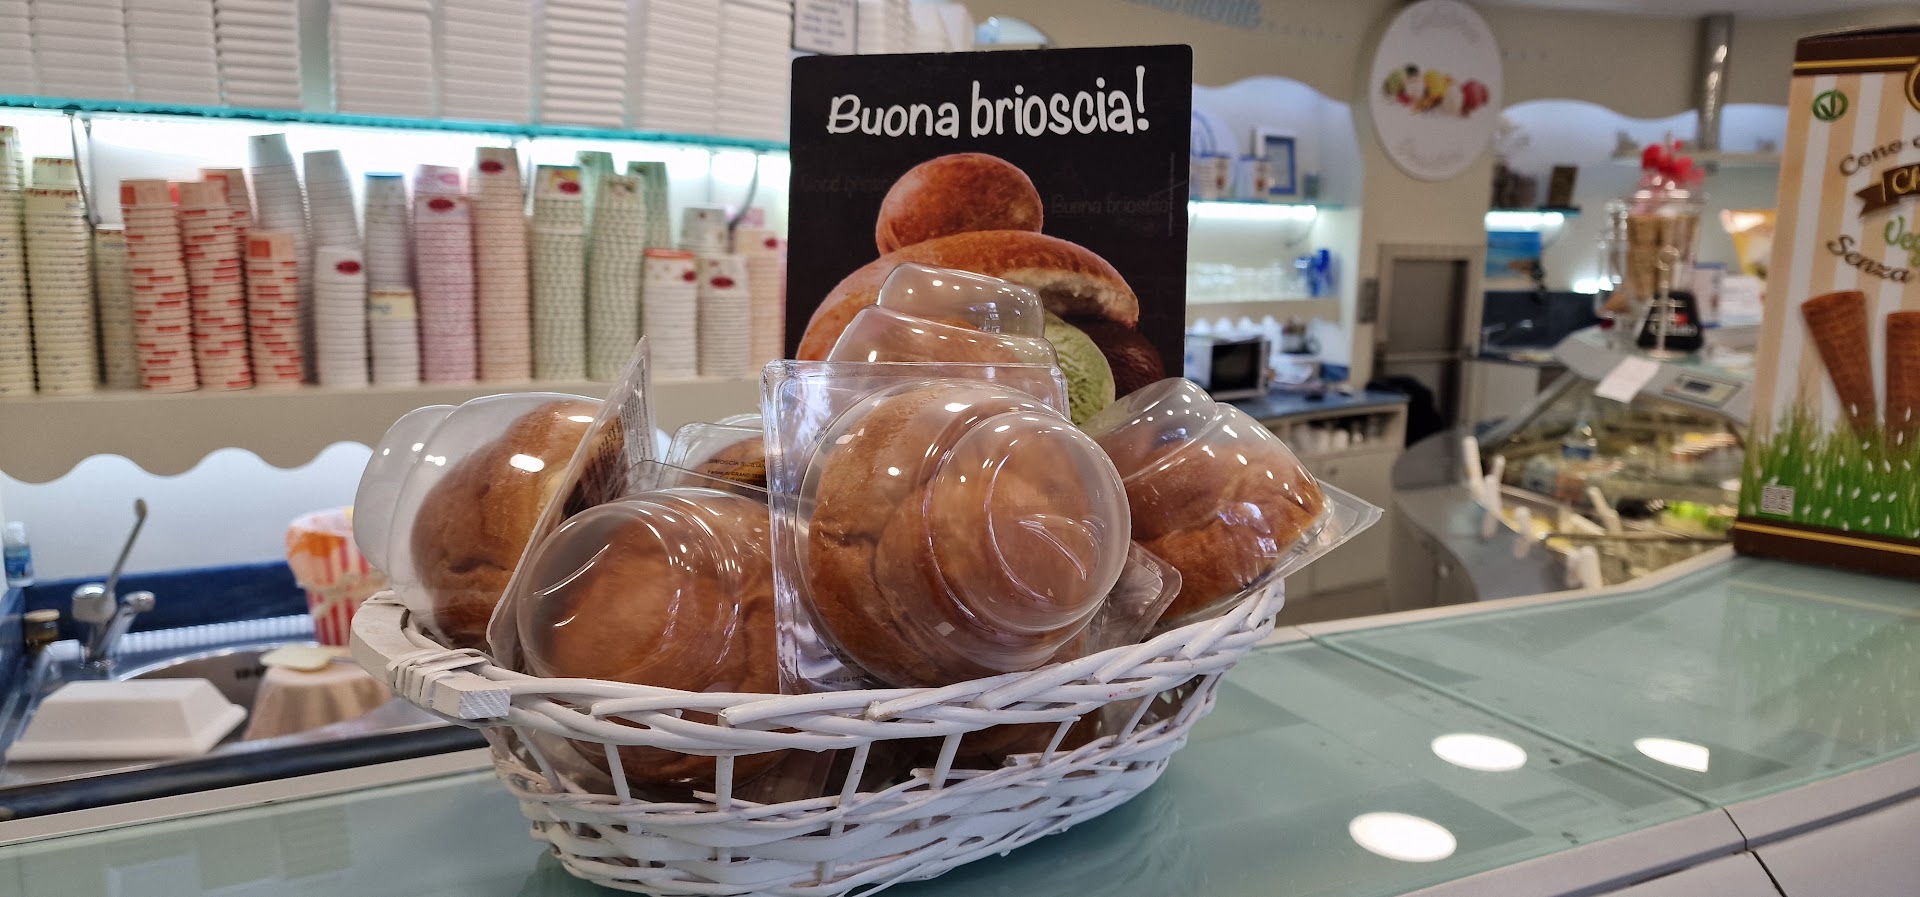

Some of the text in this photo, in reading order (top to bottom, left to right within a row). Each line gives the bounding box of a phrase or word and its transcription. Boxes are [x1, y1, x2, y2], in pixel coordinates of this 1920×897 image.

[826, 65, 1149, 139] Buona brioscia!
[1826, 234, 1911, 283] Senza
[741, 461, 766, 469] SICILIAN
